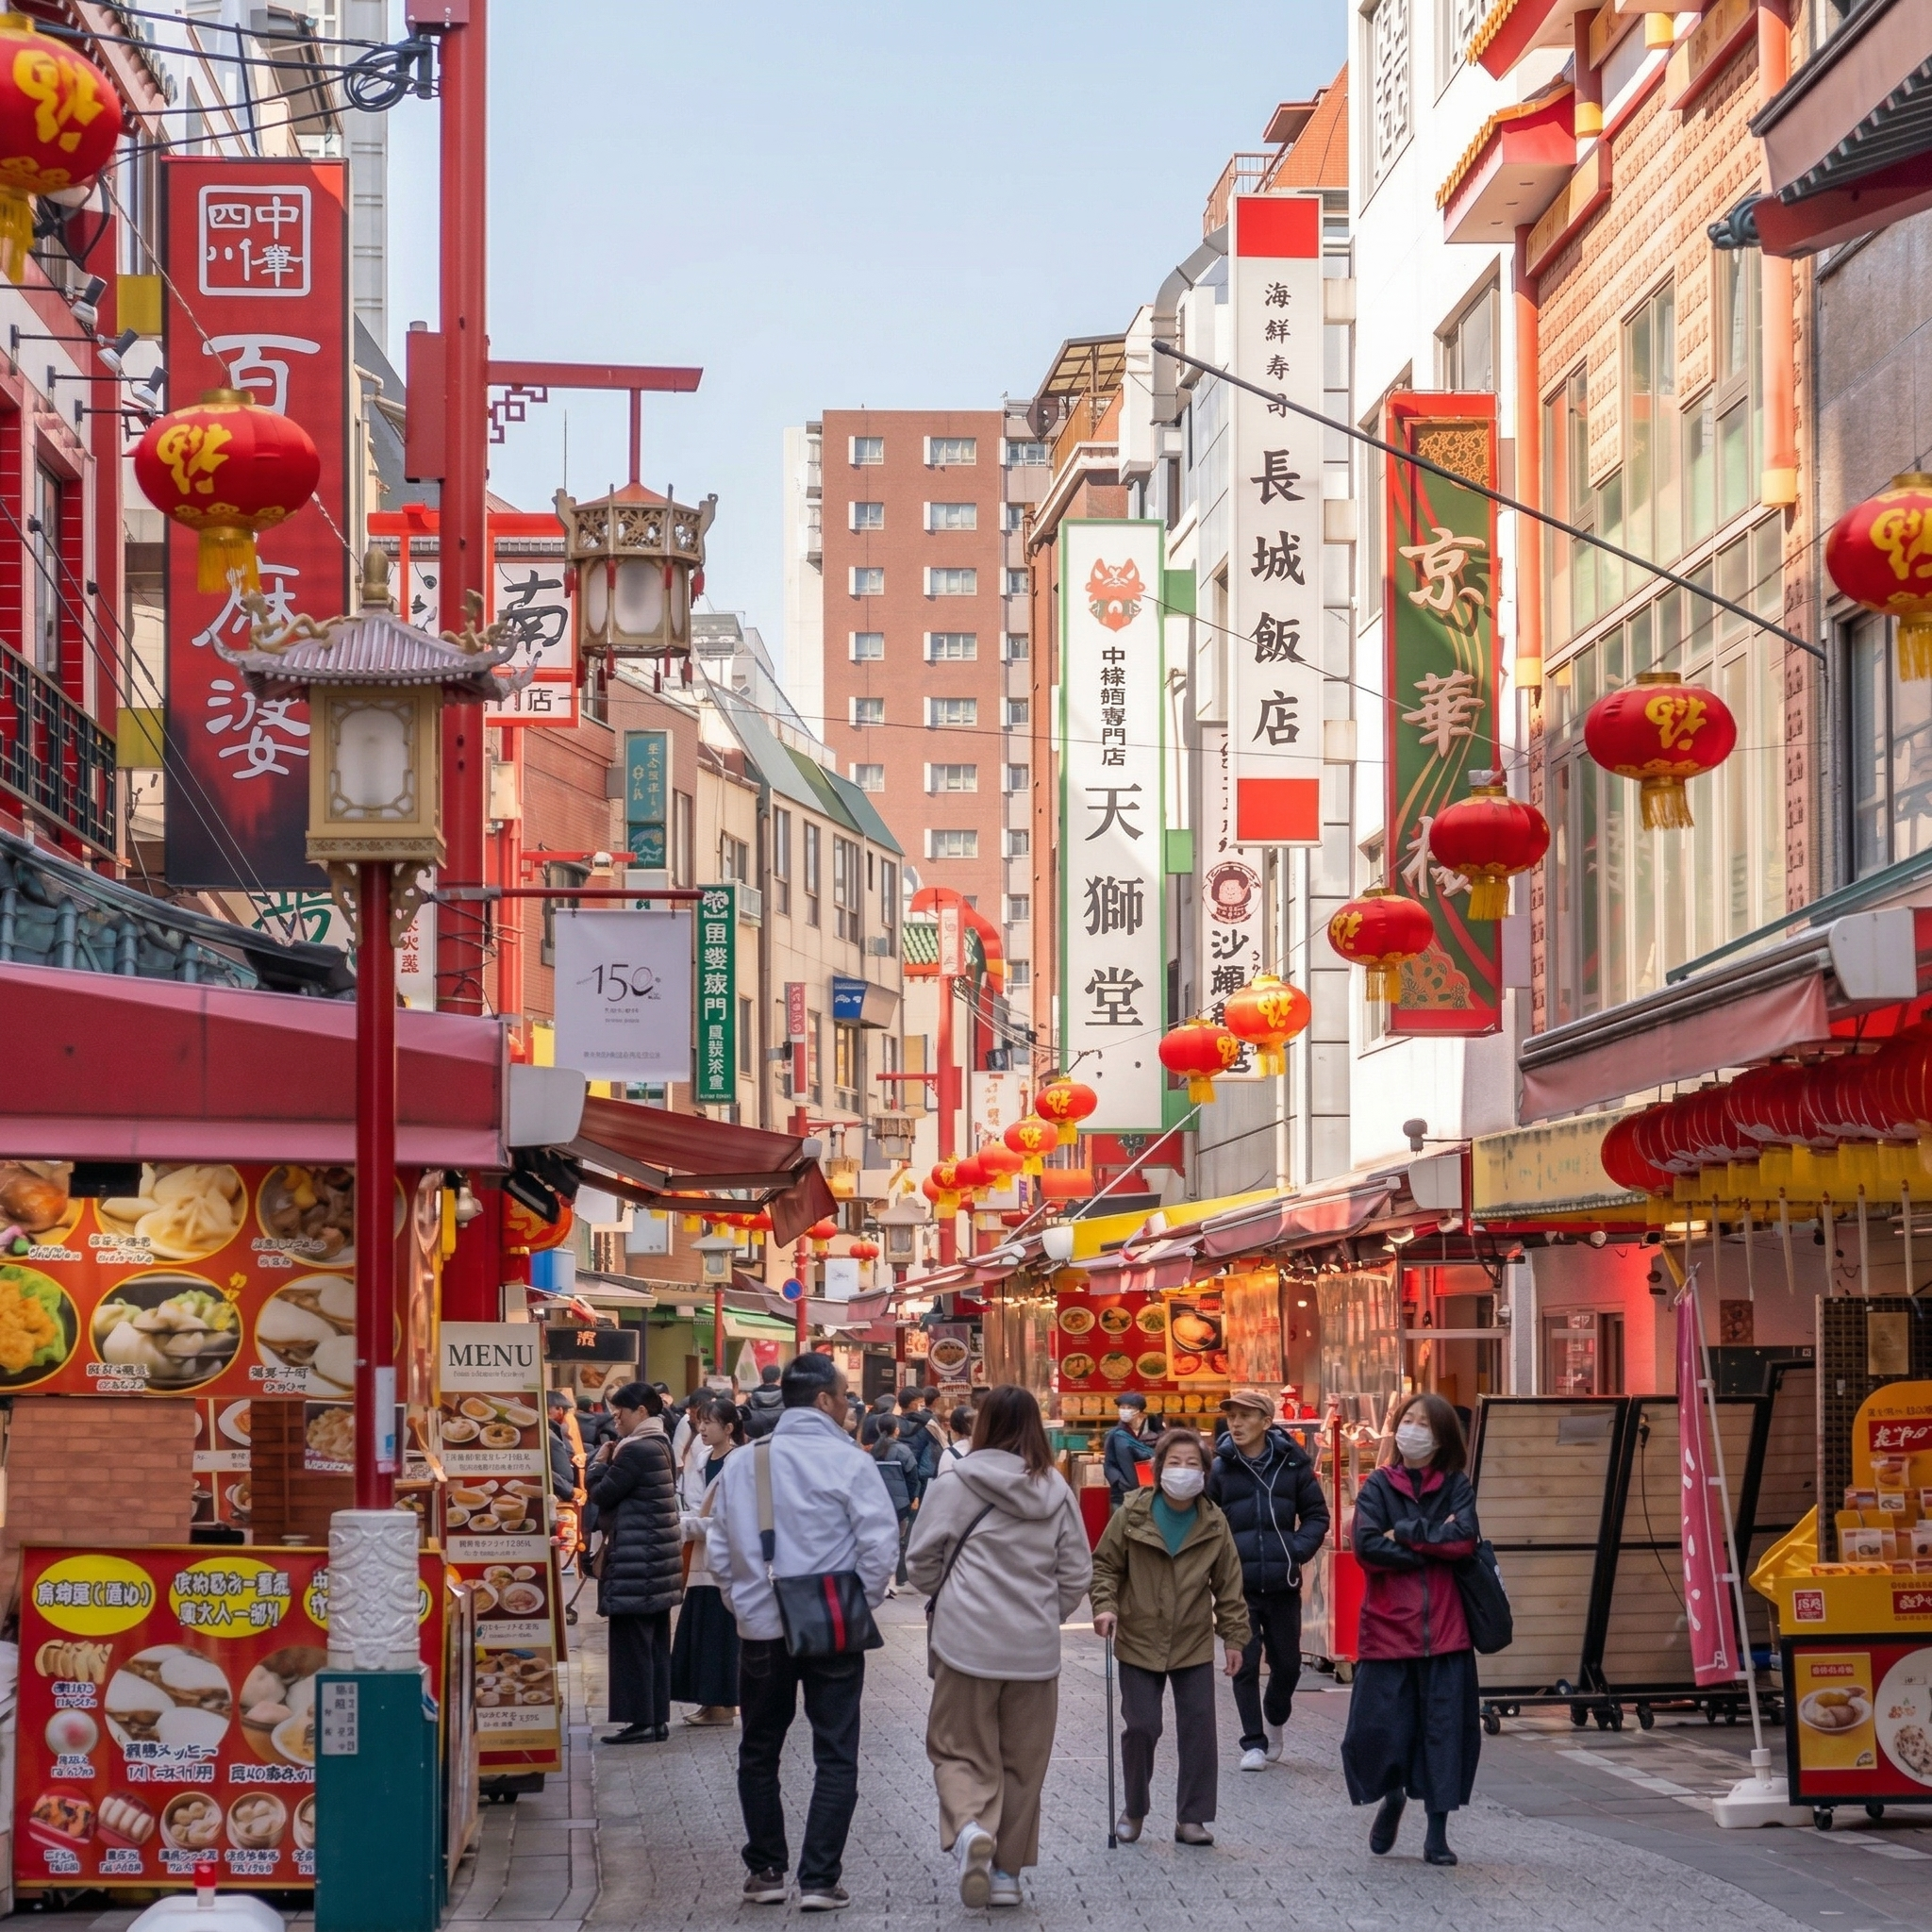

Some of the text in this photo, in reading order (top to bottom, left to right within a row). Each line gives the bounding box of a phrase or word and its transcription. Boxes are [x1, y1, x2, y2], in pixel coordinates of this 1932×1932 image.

[1264, 281, 1292, 419] 海鮮寿司
[1249, 447, 1307, 747] 長城飯店
[1084, 783, 1144, 1026] 天獅堂
[448, 1343, 534, 1368] MENU
